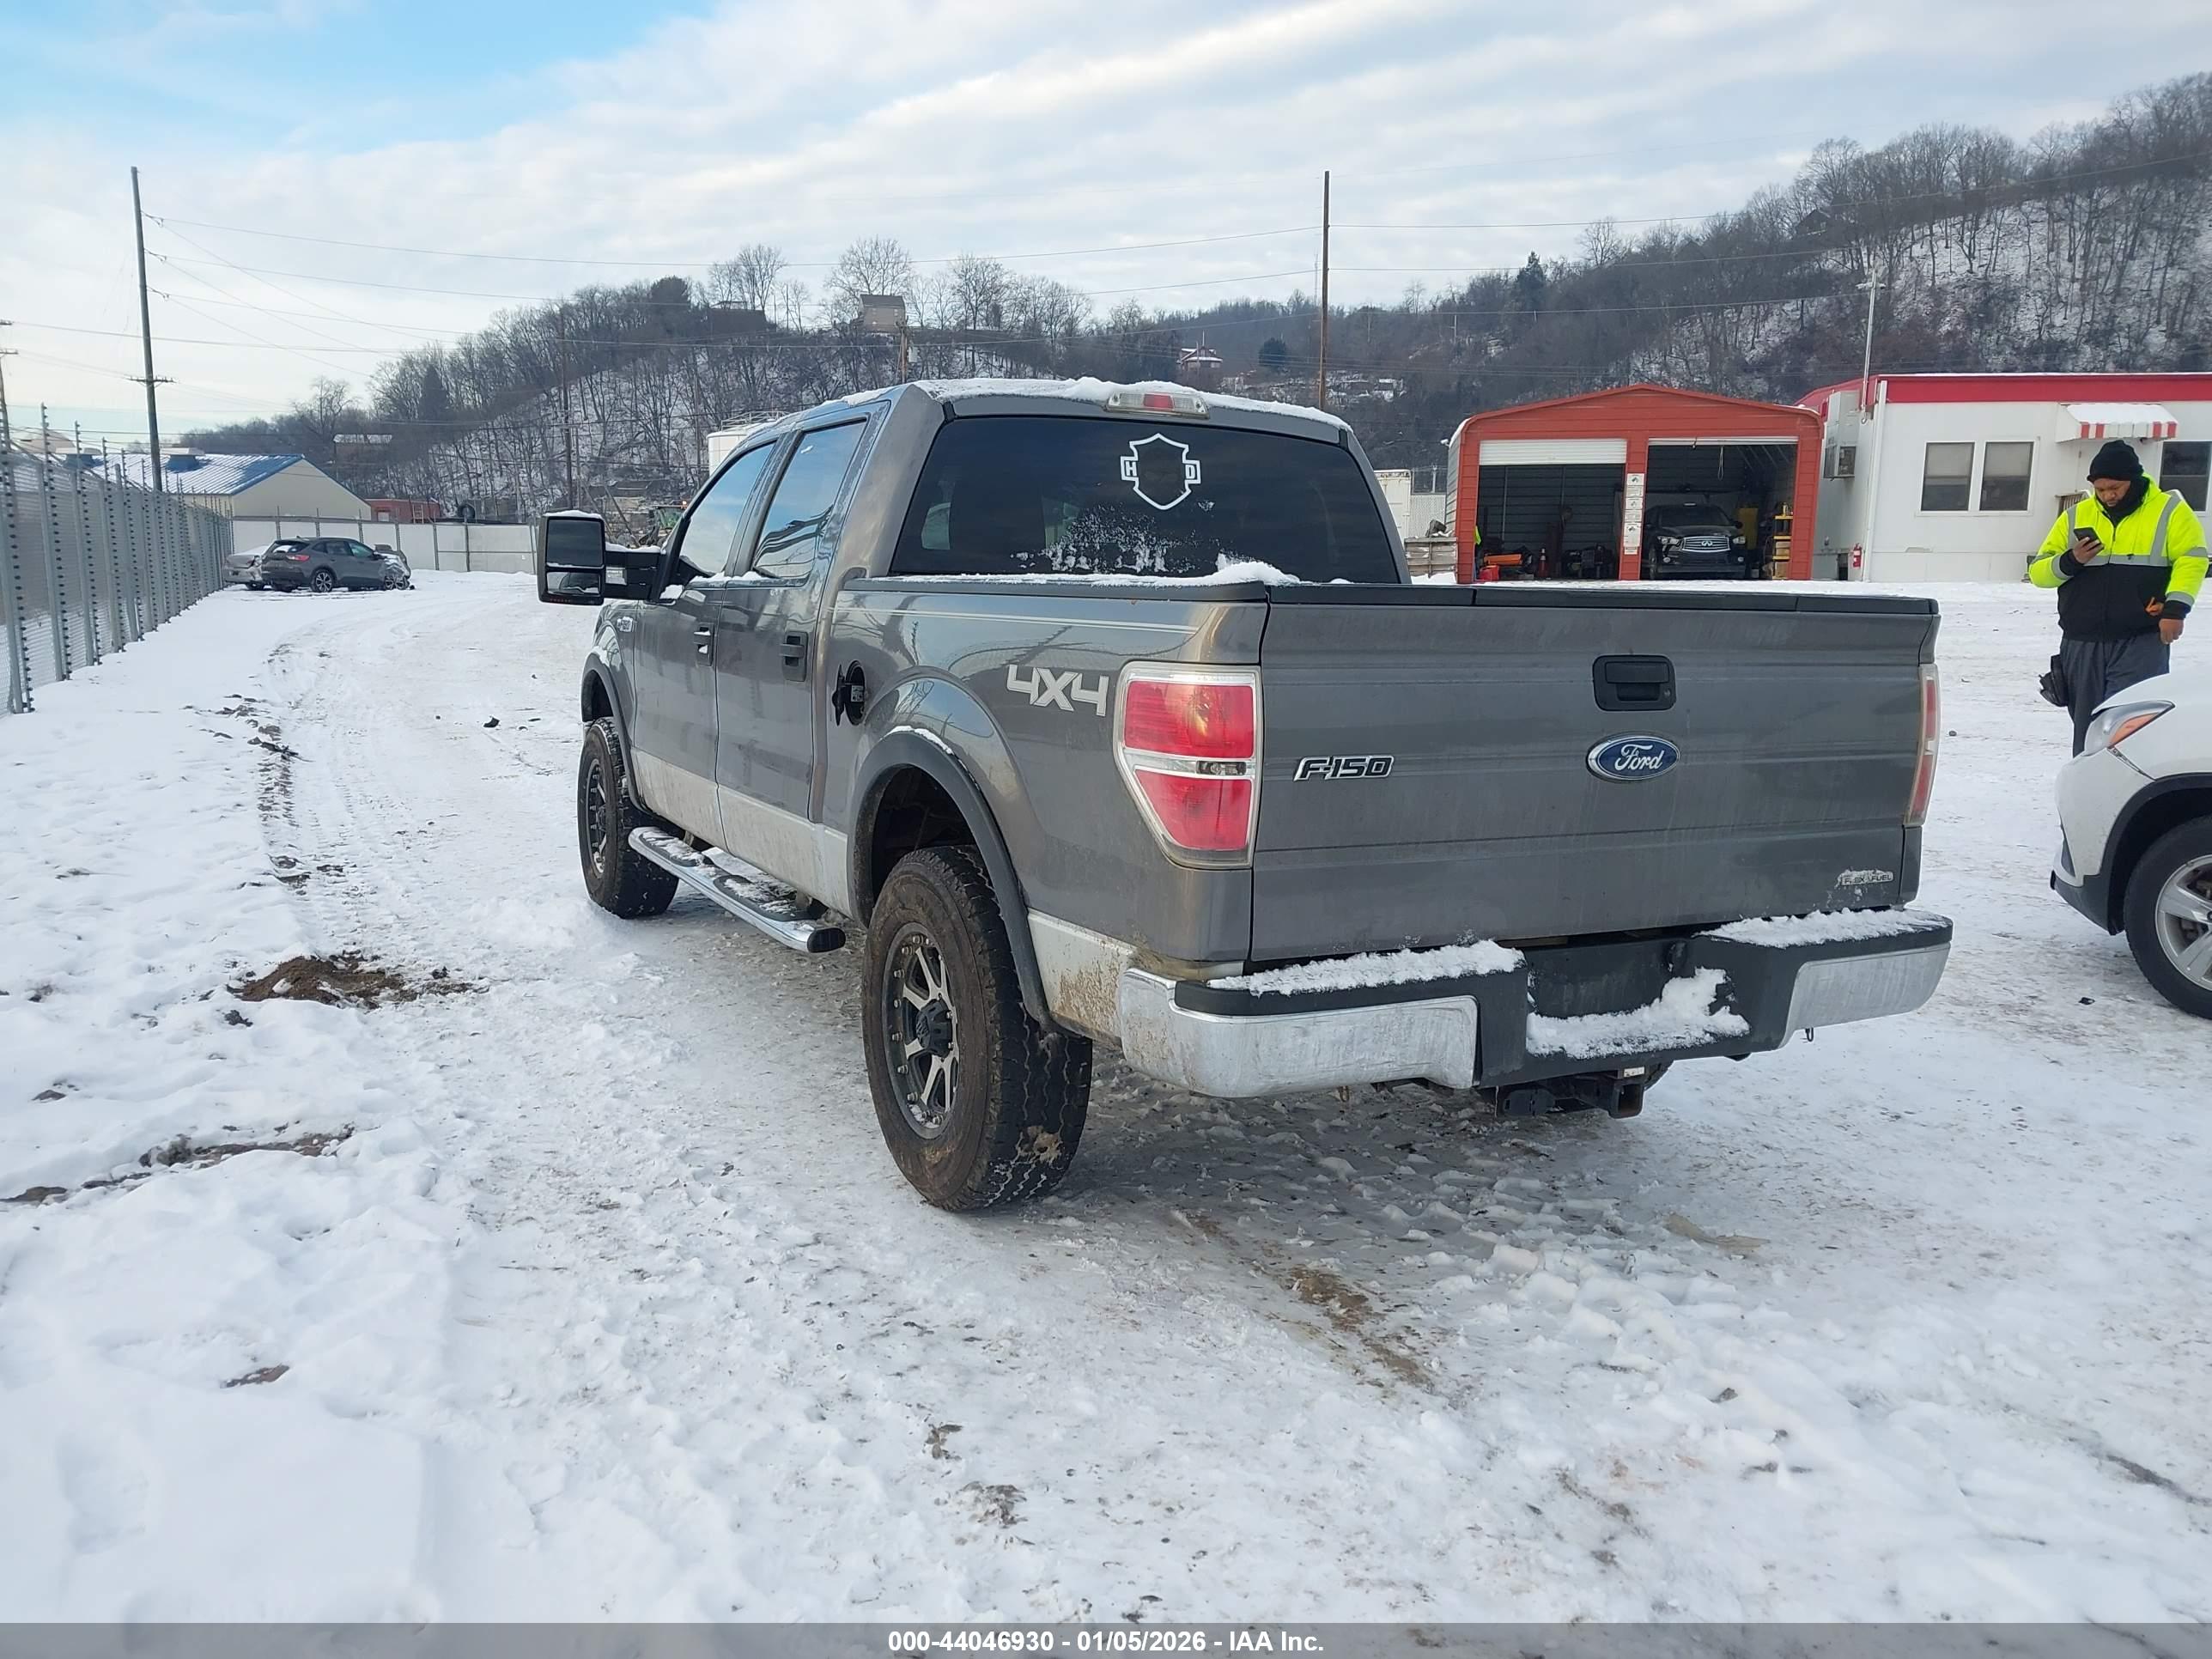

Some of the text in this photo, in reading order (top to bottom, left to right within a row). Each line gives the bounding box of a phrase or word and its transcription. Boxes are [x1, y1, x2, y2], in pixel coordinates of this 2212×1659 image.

[1125, 460, 1196, 479] H D
[1006, 664, 1109, 717] 4X4
[1293, 756, 1394, 781] F-150
[1614, 744, 1665, 771] Ford
